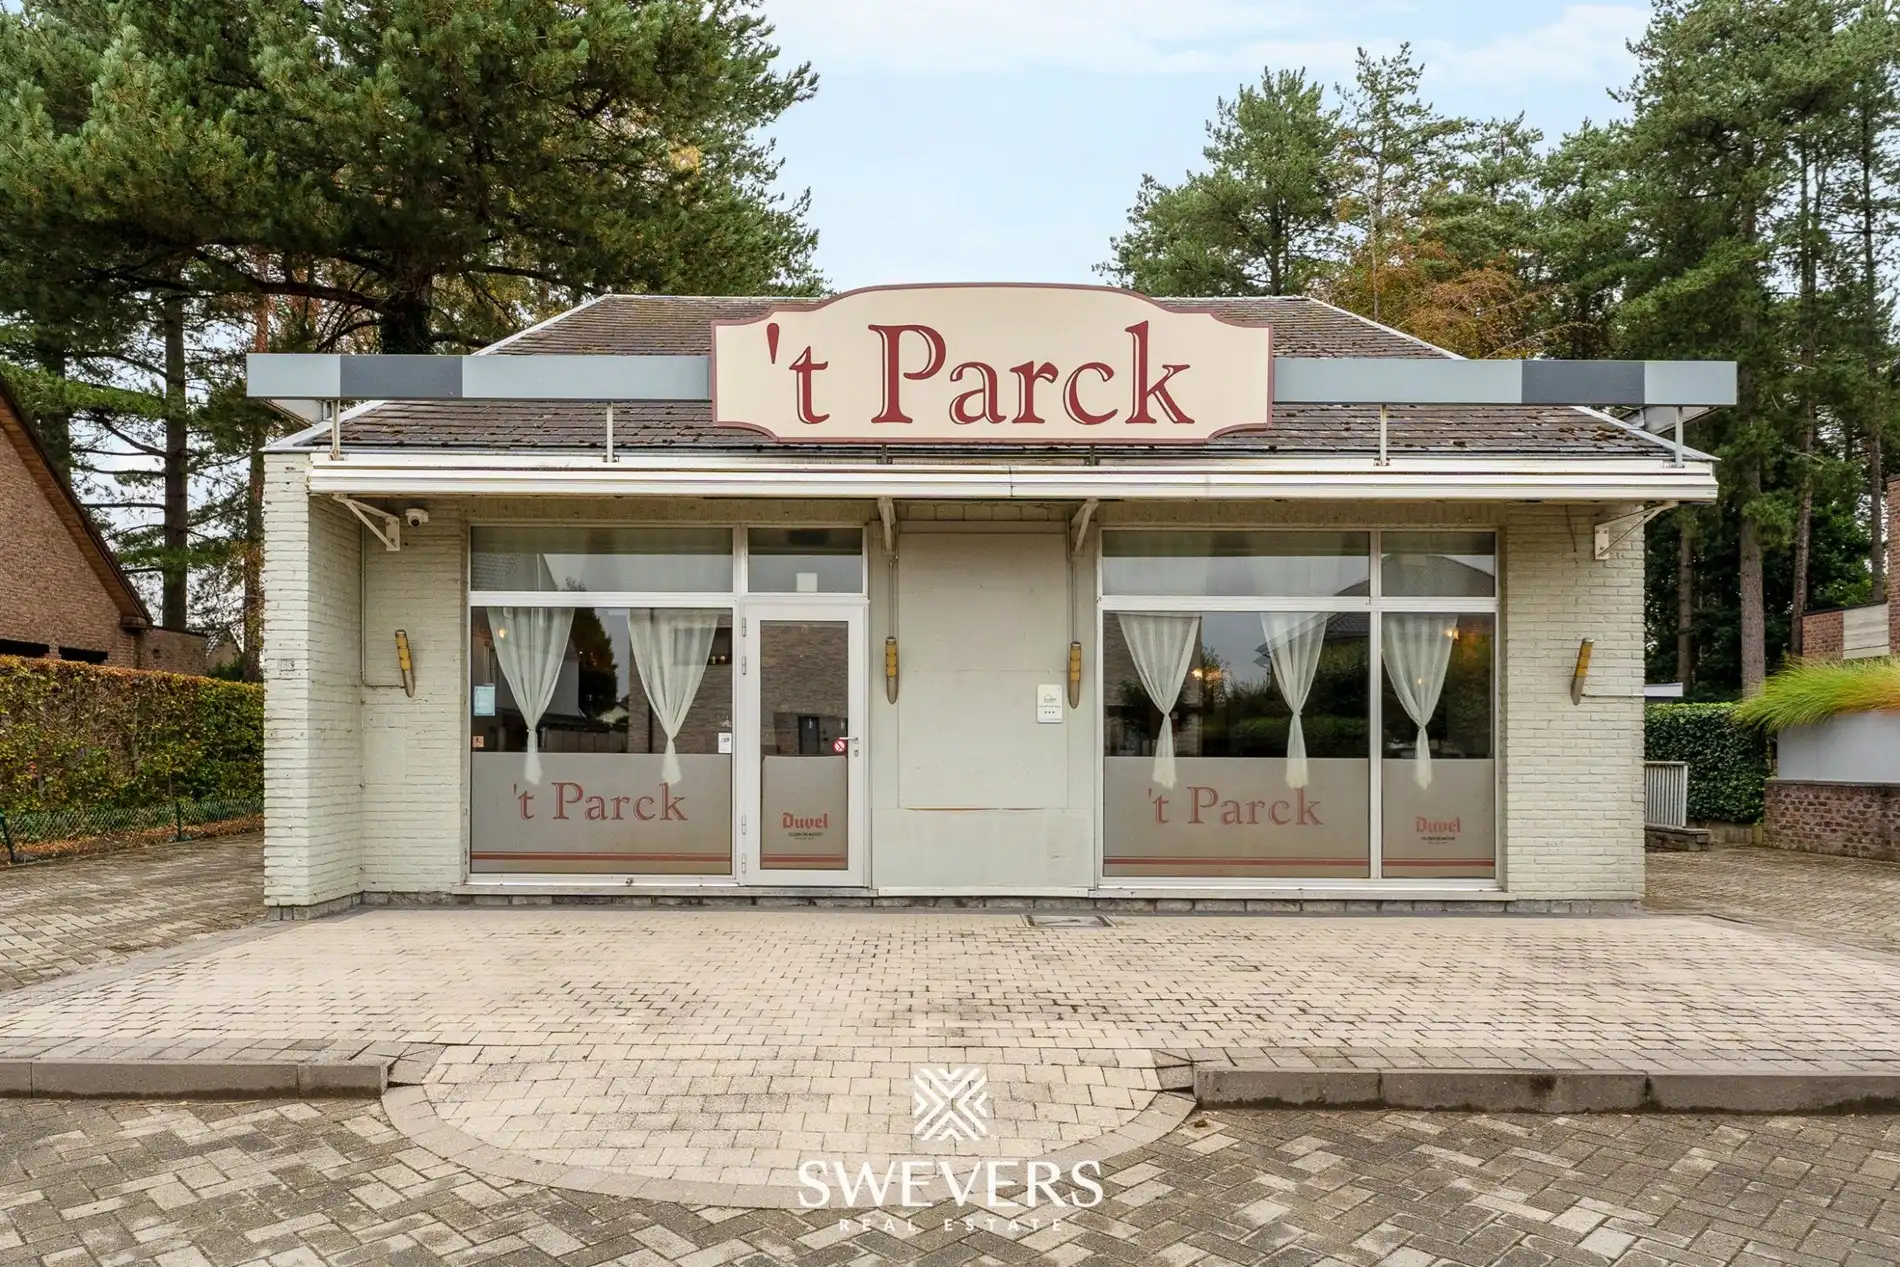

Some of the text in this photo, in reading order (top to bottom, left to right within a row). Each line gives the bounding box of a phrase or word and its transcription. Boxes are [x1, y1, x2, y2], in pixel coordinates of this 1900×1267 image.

[766, 320, 1196, 426] 't Parck
[512, 781, 689, 822] 't Parck
[782, 811, 828, 830] Duvel
[1148, 786, 1324, 826] 't Parck
[1415, 815, 1461, 834] Duvel
